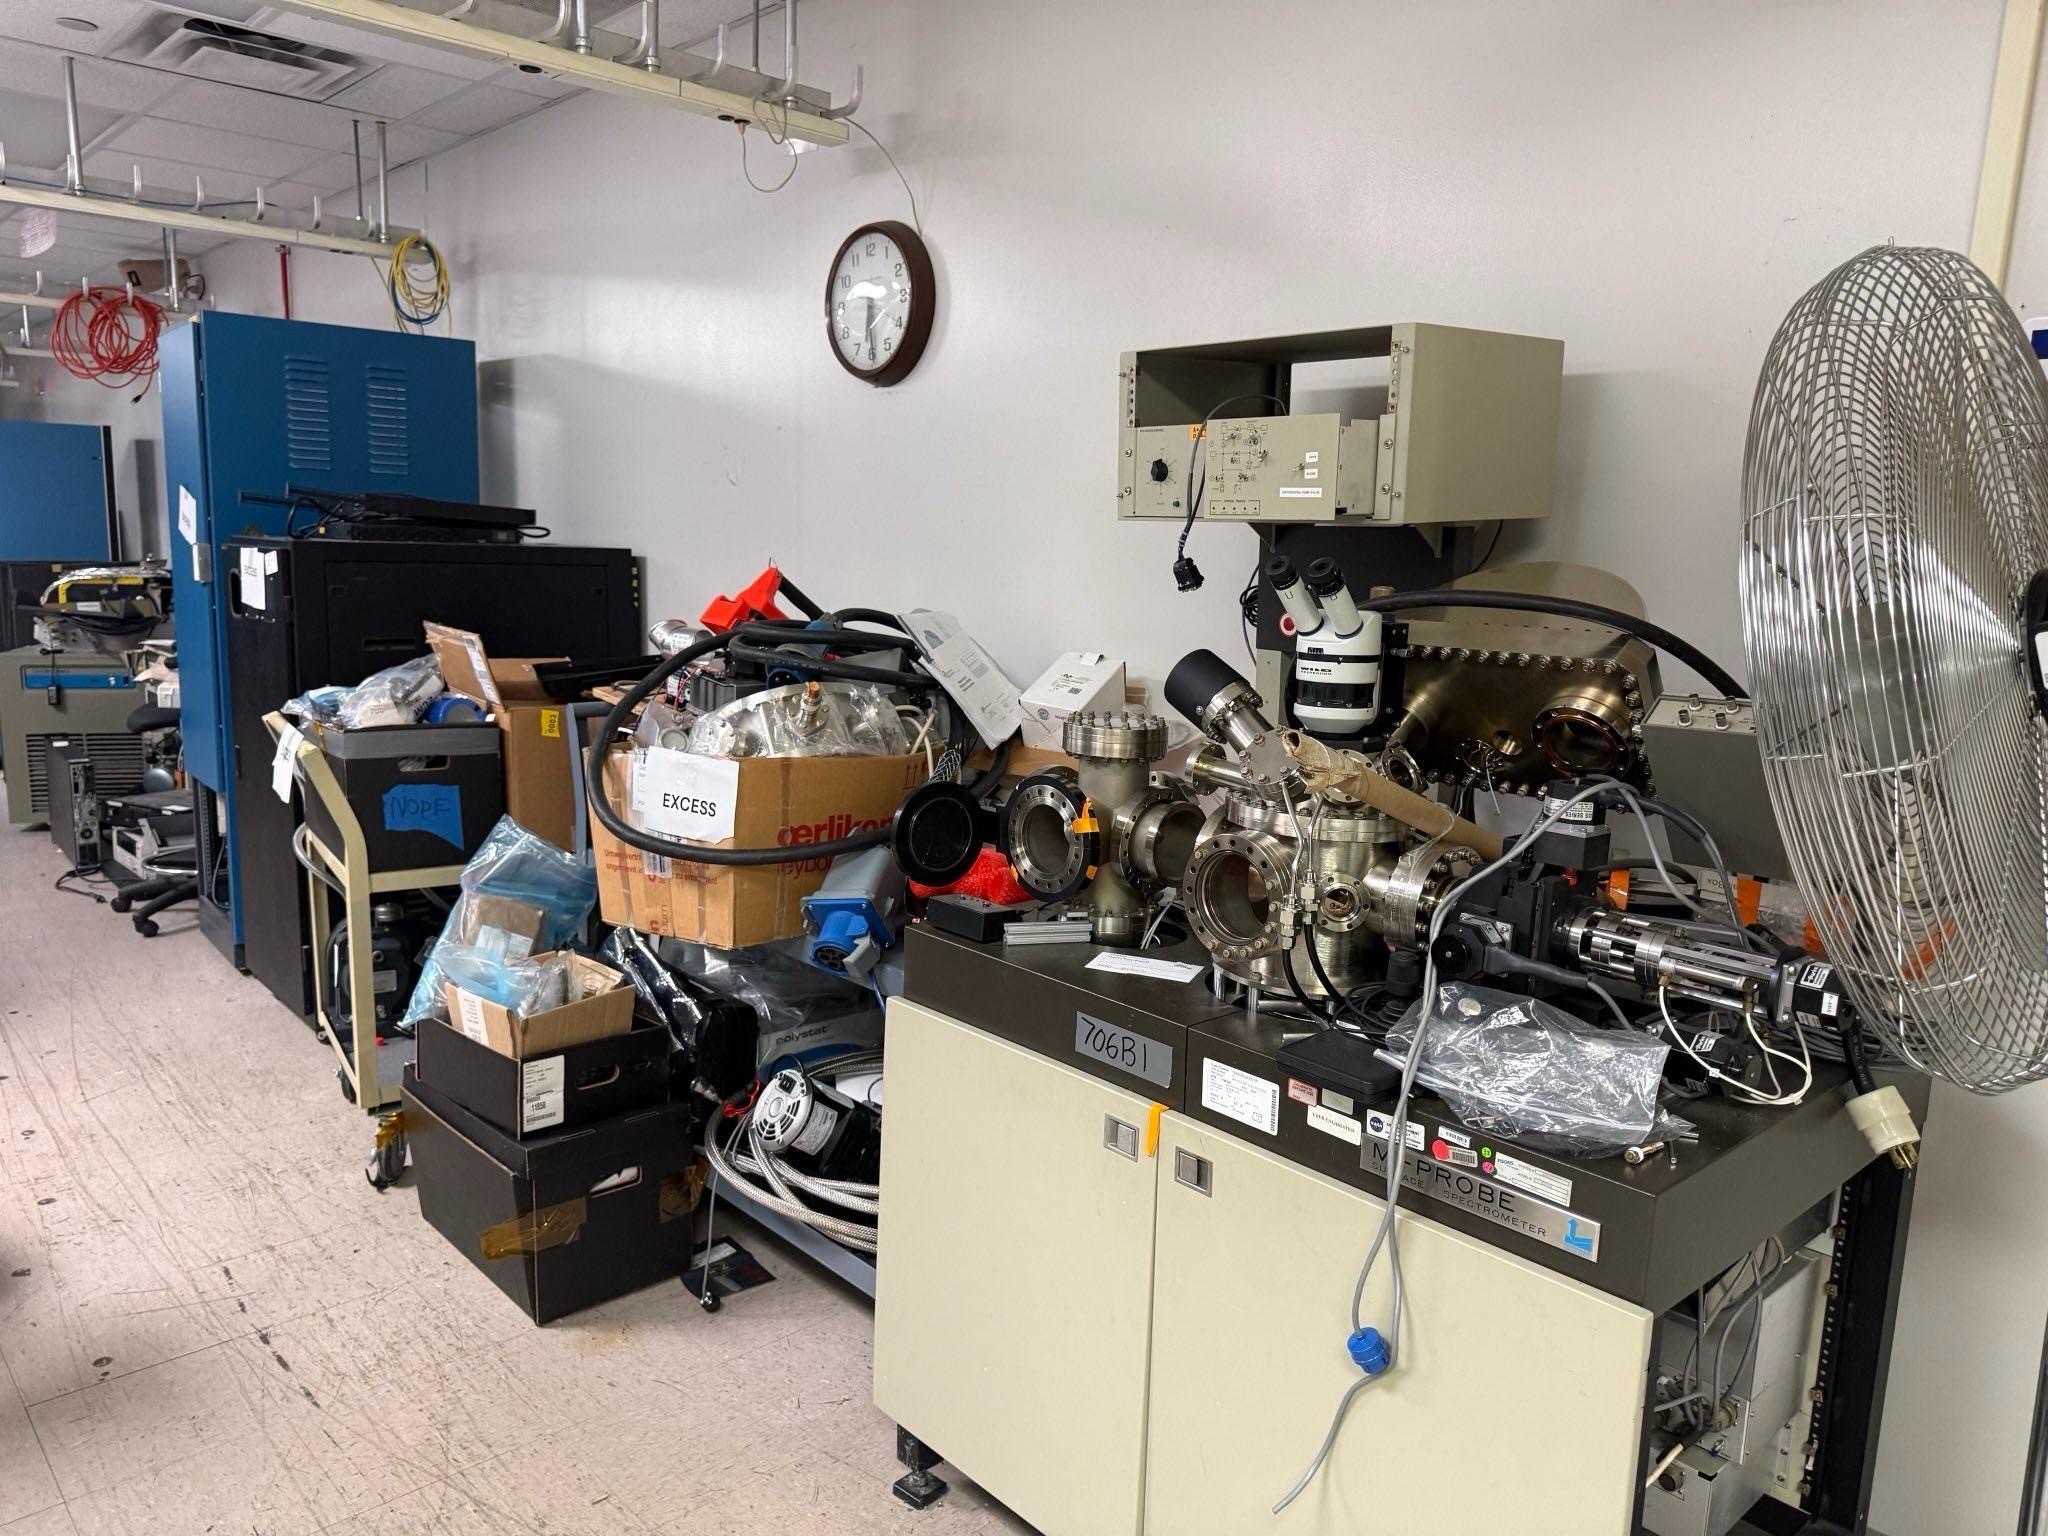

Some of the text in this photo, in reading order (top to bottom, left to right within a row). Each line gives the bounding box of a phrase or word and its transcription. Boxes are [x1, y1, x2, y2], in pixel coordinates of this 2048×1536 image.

[865, 242, 877, 257] 12
[851, 254, 860, 267] 11
[894, 263, 903, 277] 2
[840, 274, 852, 288] 10
[899, 288, 908, 303] 3
[895, 316, 904, 329] 4
[842, 326, 850, 340] 8
[853, 343, 861, 356] 7
[883, 337, 892, 351] 5
[868, 348, 876, 361] 6
[390, 796, 450, 819] NOPE
[662, 793, 717, 817] EXCESS
[775, 1025, 828, 1046] polystat
[1371, 1161, 1547, 1238] SUACE SPECTROMETER
